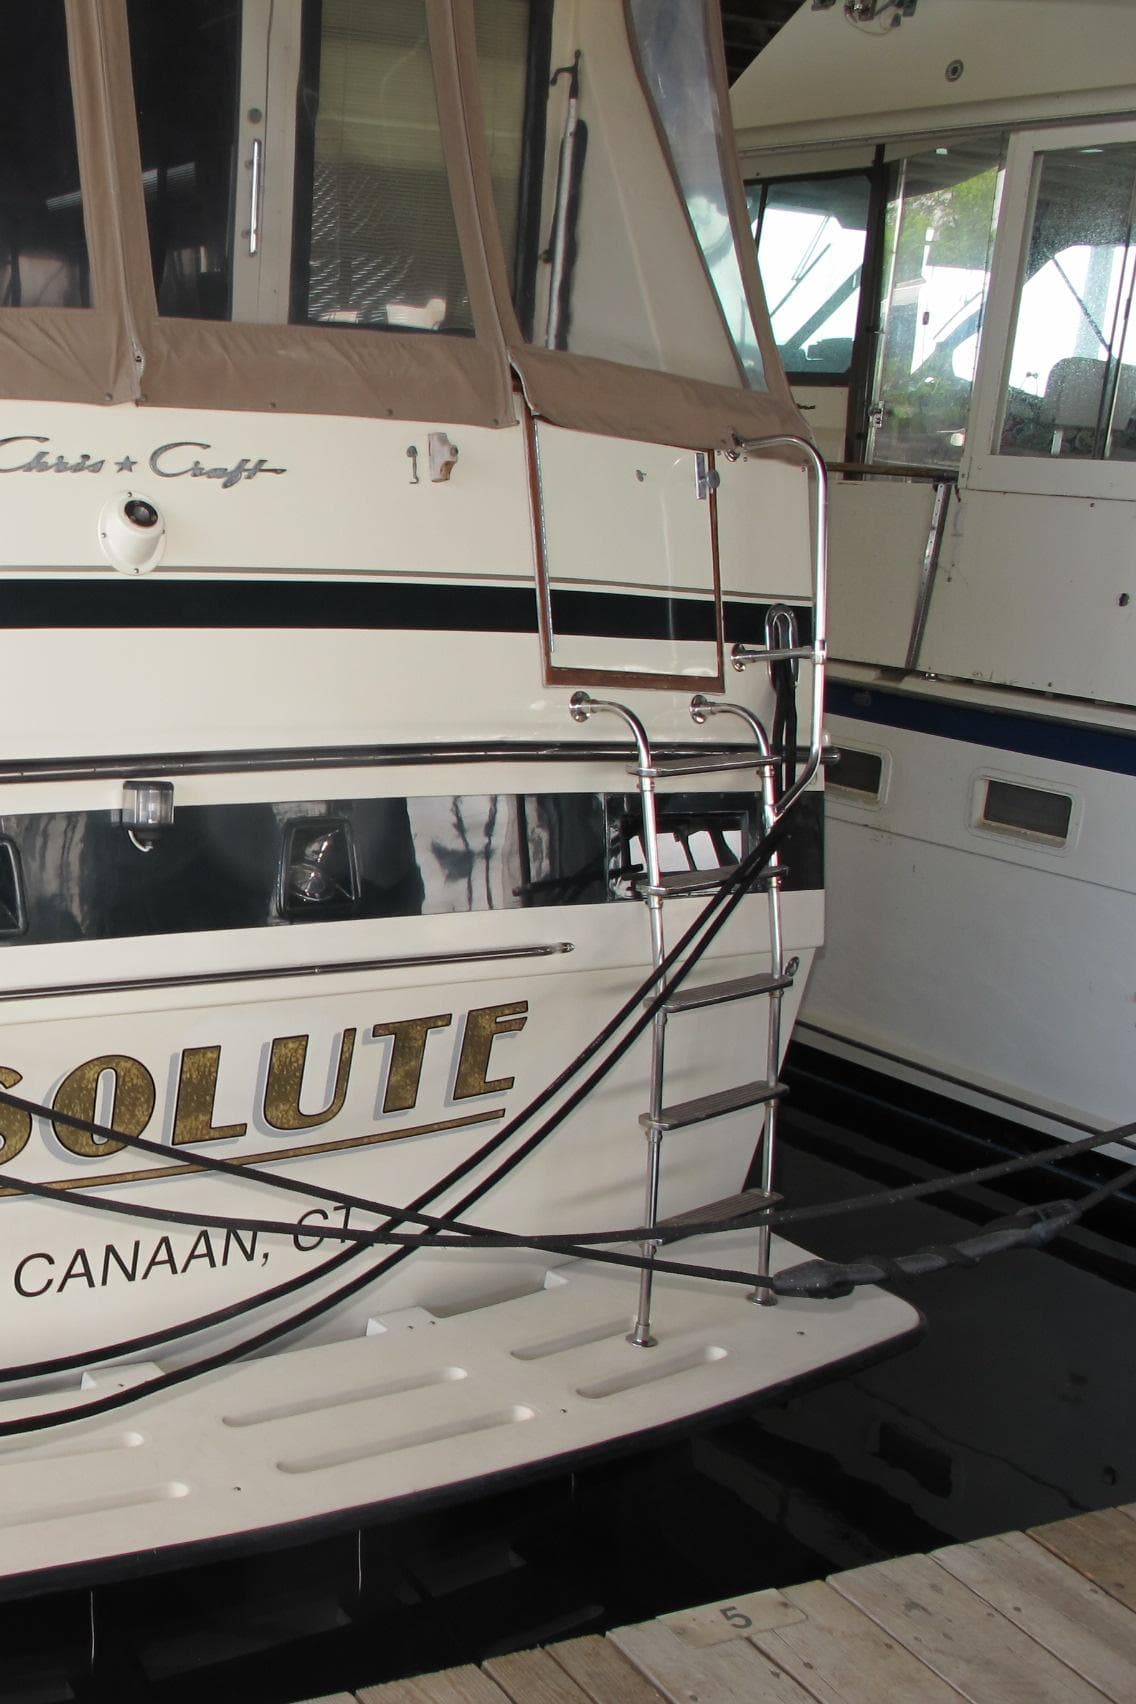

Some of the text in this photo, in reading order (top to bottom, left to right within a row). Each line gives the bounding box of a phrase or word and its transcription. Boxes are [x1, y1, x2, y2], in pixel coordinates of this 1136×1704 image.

[148, 441, 288, 489] Craft
[13, 1227, 270, 1298] CANAAN,
[719, 1605, 753, 1630] 5
